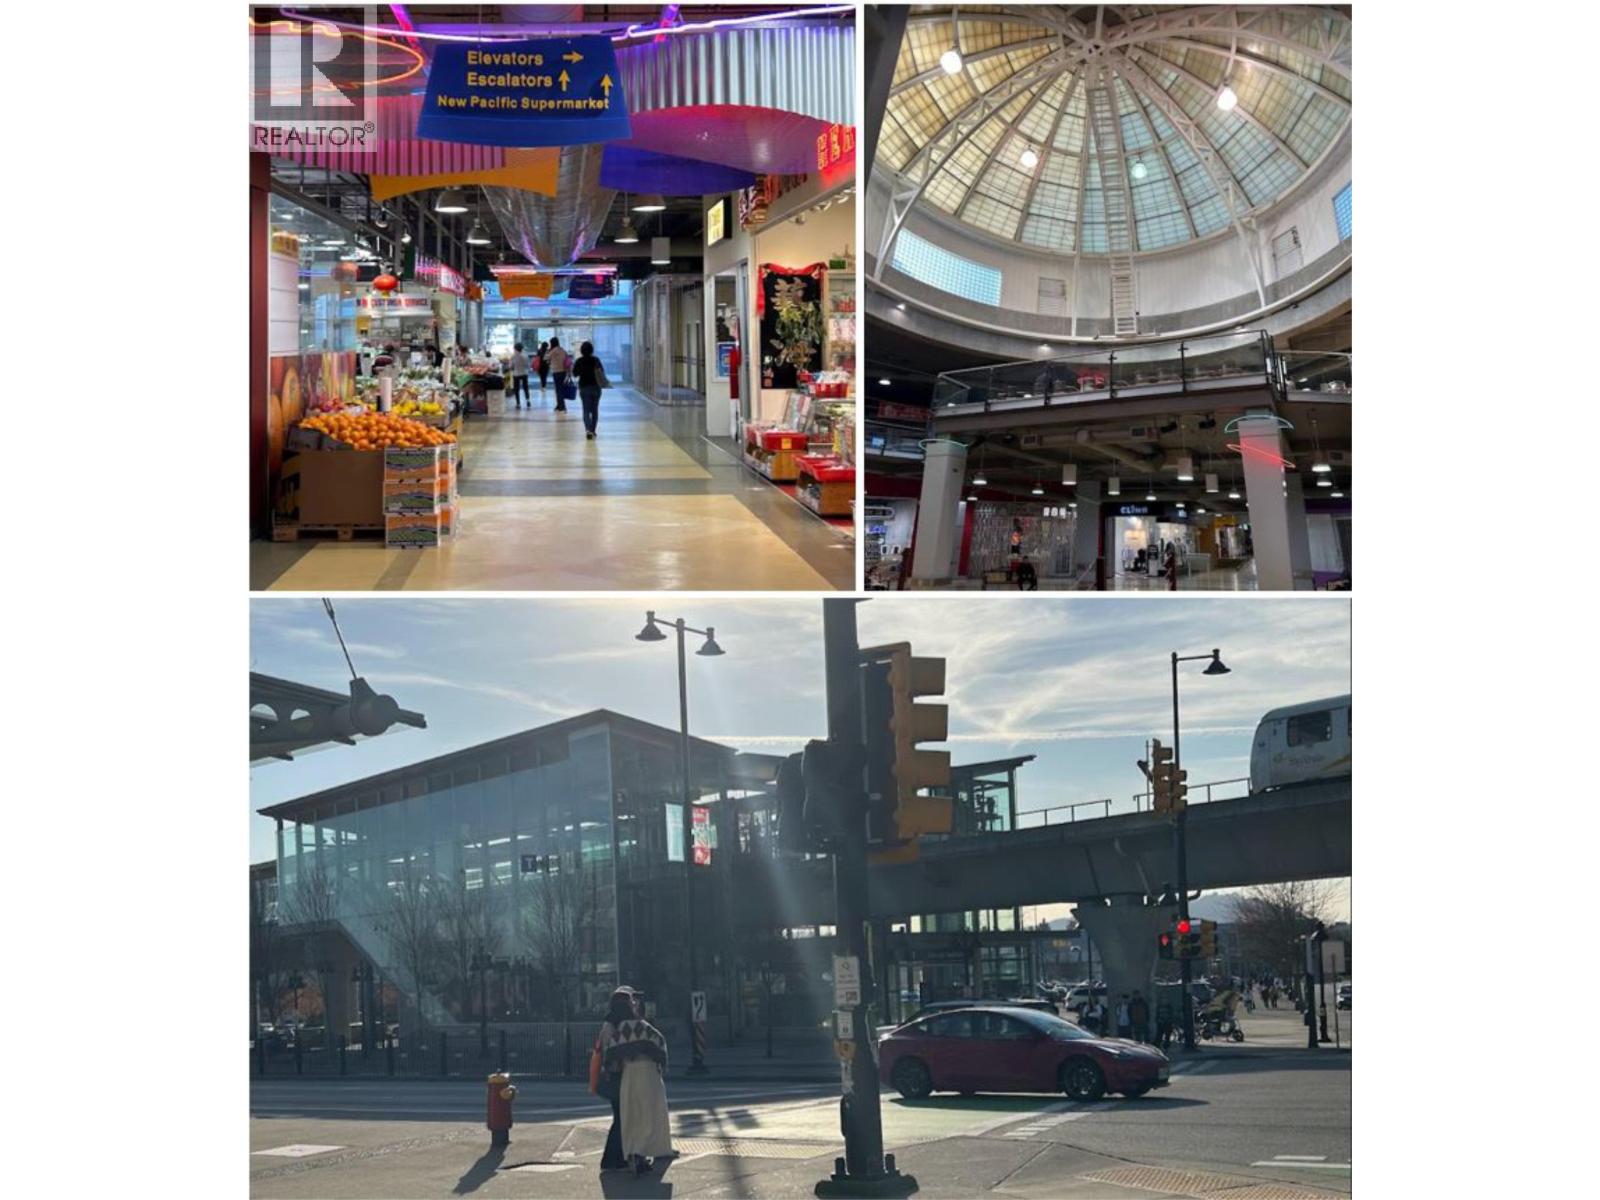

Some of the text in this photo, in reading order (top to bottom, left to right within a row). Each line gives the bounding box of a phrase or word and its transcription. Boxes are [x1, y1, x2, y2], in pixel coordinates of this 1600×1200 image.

[467, 51, 544, 65] Elevators
[467, 72, 553, 88] Escalators
[437, 95, 610, 112] New Pacific Supermarket
